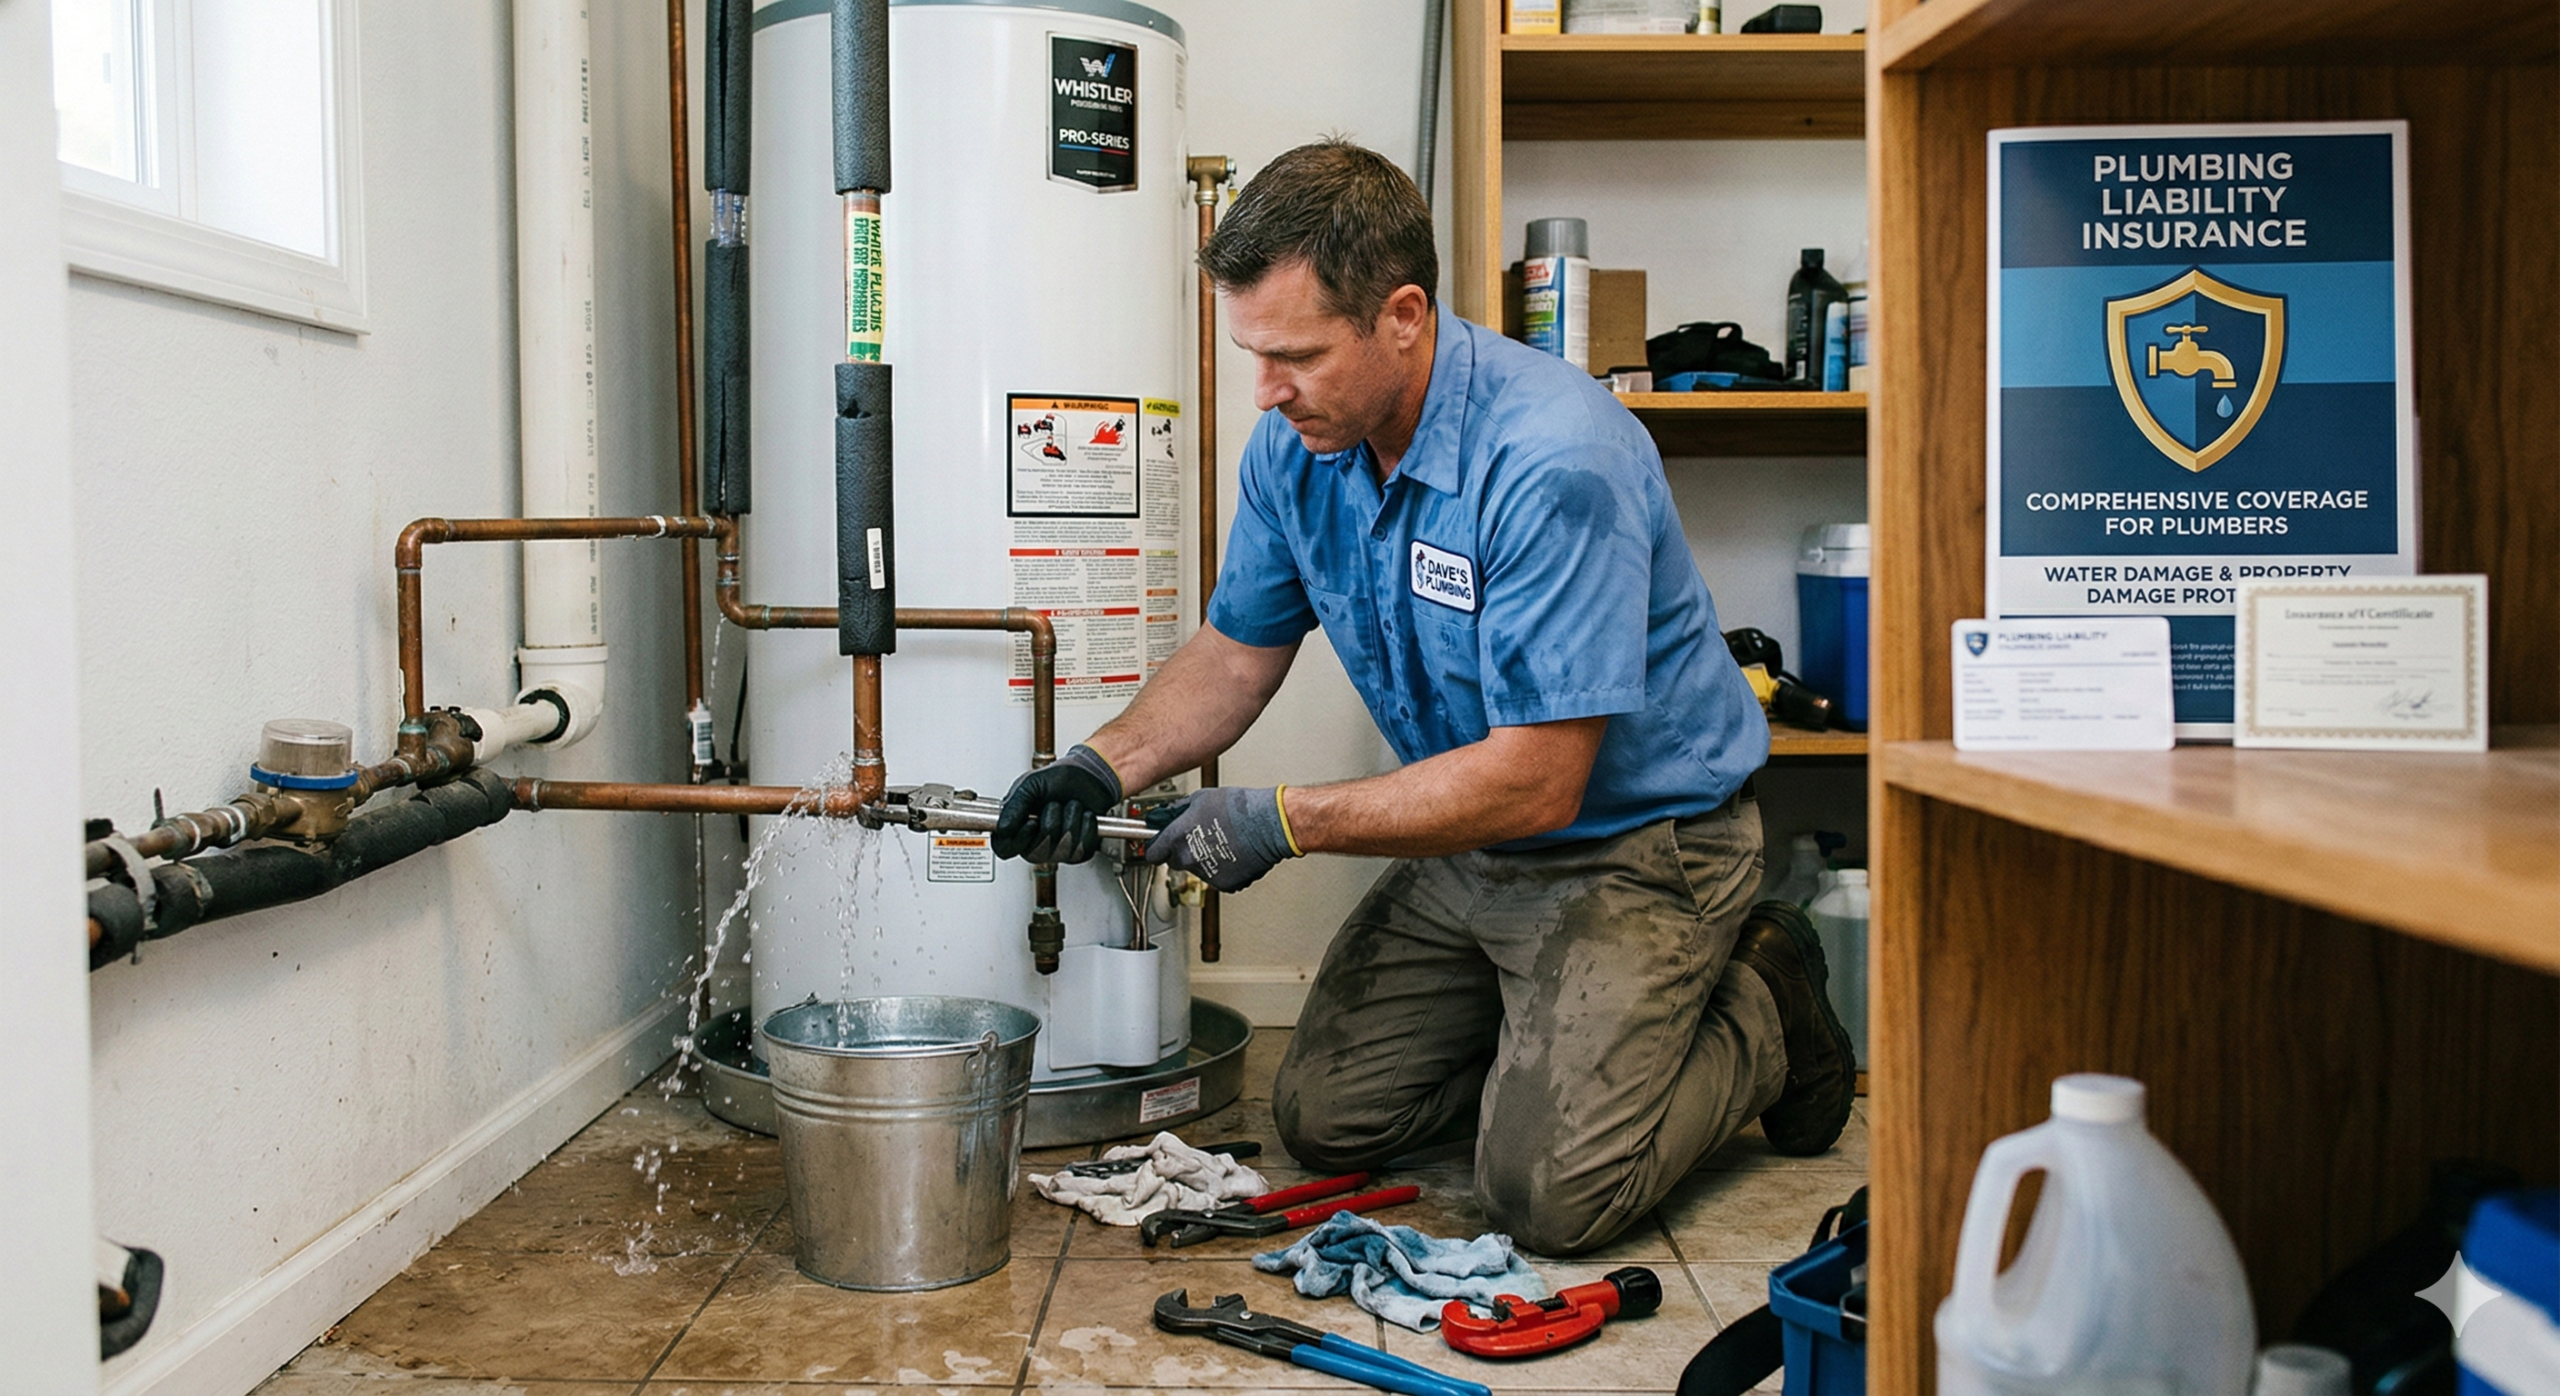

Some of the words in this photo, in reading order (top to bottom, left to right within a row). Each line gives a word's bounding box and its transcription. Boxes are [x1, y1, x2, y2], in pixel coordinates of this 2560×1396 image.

[1054, 78, 1133, 105] WHISTLER
[1059, 128, 1130, 150] PRO-SERIES
[2095, 153, 2292, 181] PLUMBING
[2103, 187, 2286, 215] LIABILITY
[2084, 219, 2306, 249] INSURANCE
[2026, 491, 2229, 512] COMPREHENSIVE
[2236, 490, 2368, 510] COVERAGE
[2105, 517, 2154, 536] FOR
[2162, 517, 2289, 535] PLUMBERS
[1428, 559, 1468, 585] DAVE'S
[2044, 566, 2117, 582] WATER
[2124, 565, 2213, 581] DAMAGE
[2219, 565, 2233, 581] &
[2239, 565, 2352, 577] PROPERTY
[1425, 575, 1471, 600] PLUMBING
[2087, 588, 2176, 604] DAMAGE
